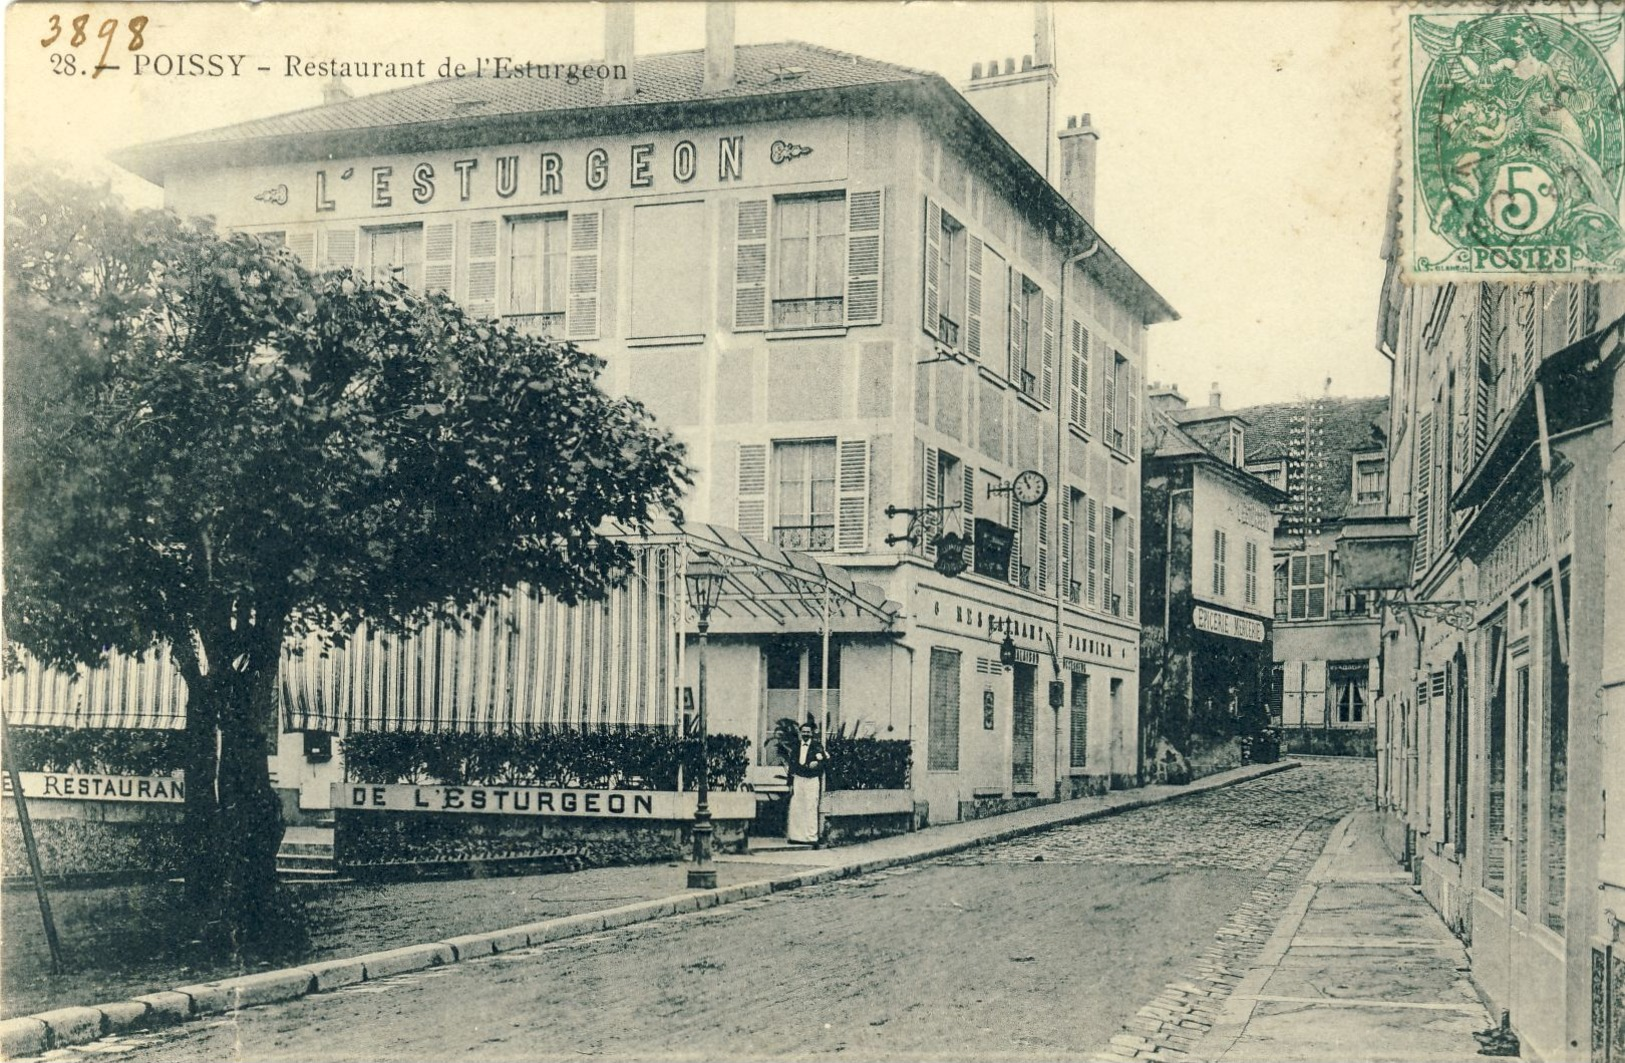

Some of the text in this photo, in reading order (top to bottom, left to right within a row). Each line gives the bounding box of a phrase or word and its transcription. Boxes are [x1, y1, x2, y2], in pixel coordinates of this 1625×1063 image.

[41, 14, 149, 79] 3898
[316, 136, 744, 212] L'ESTURGEON
[1501, 166, 1538, 230] 5
[1474, 247, 1568, 271] POSTES
[956, 605, 1043, 641] RESTARANT
[352, 787, 653, 815] DE L'ESTURGEON
